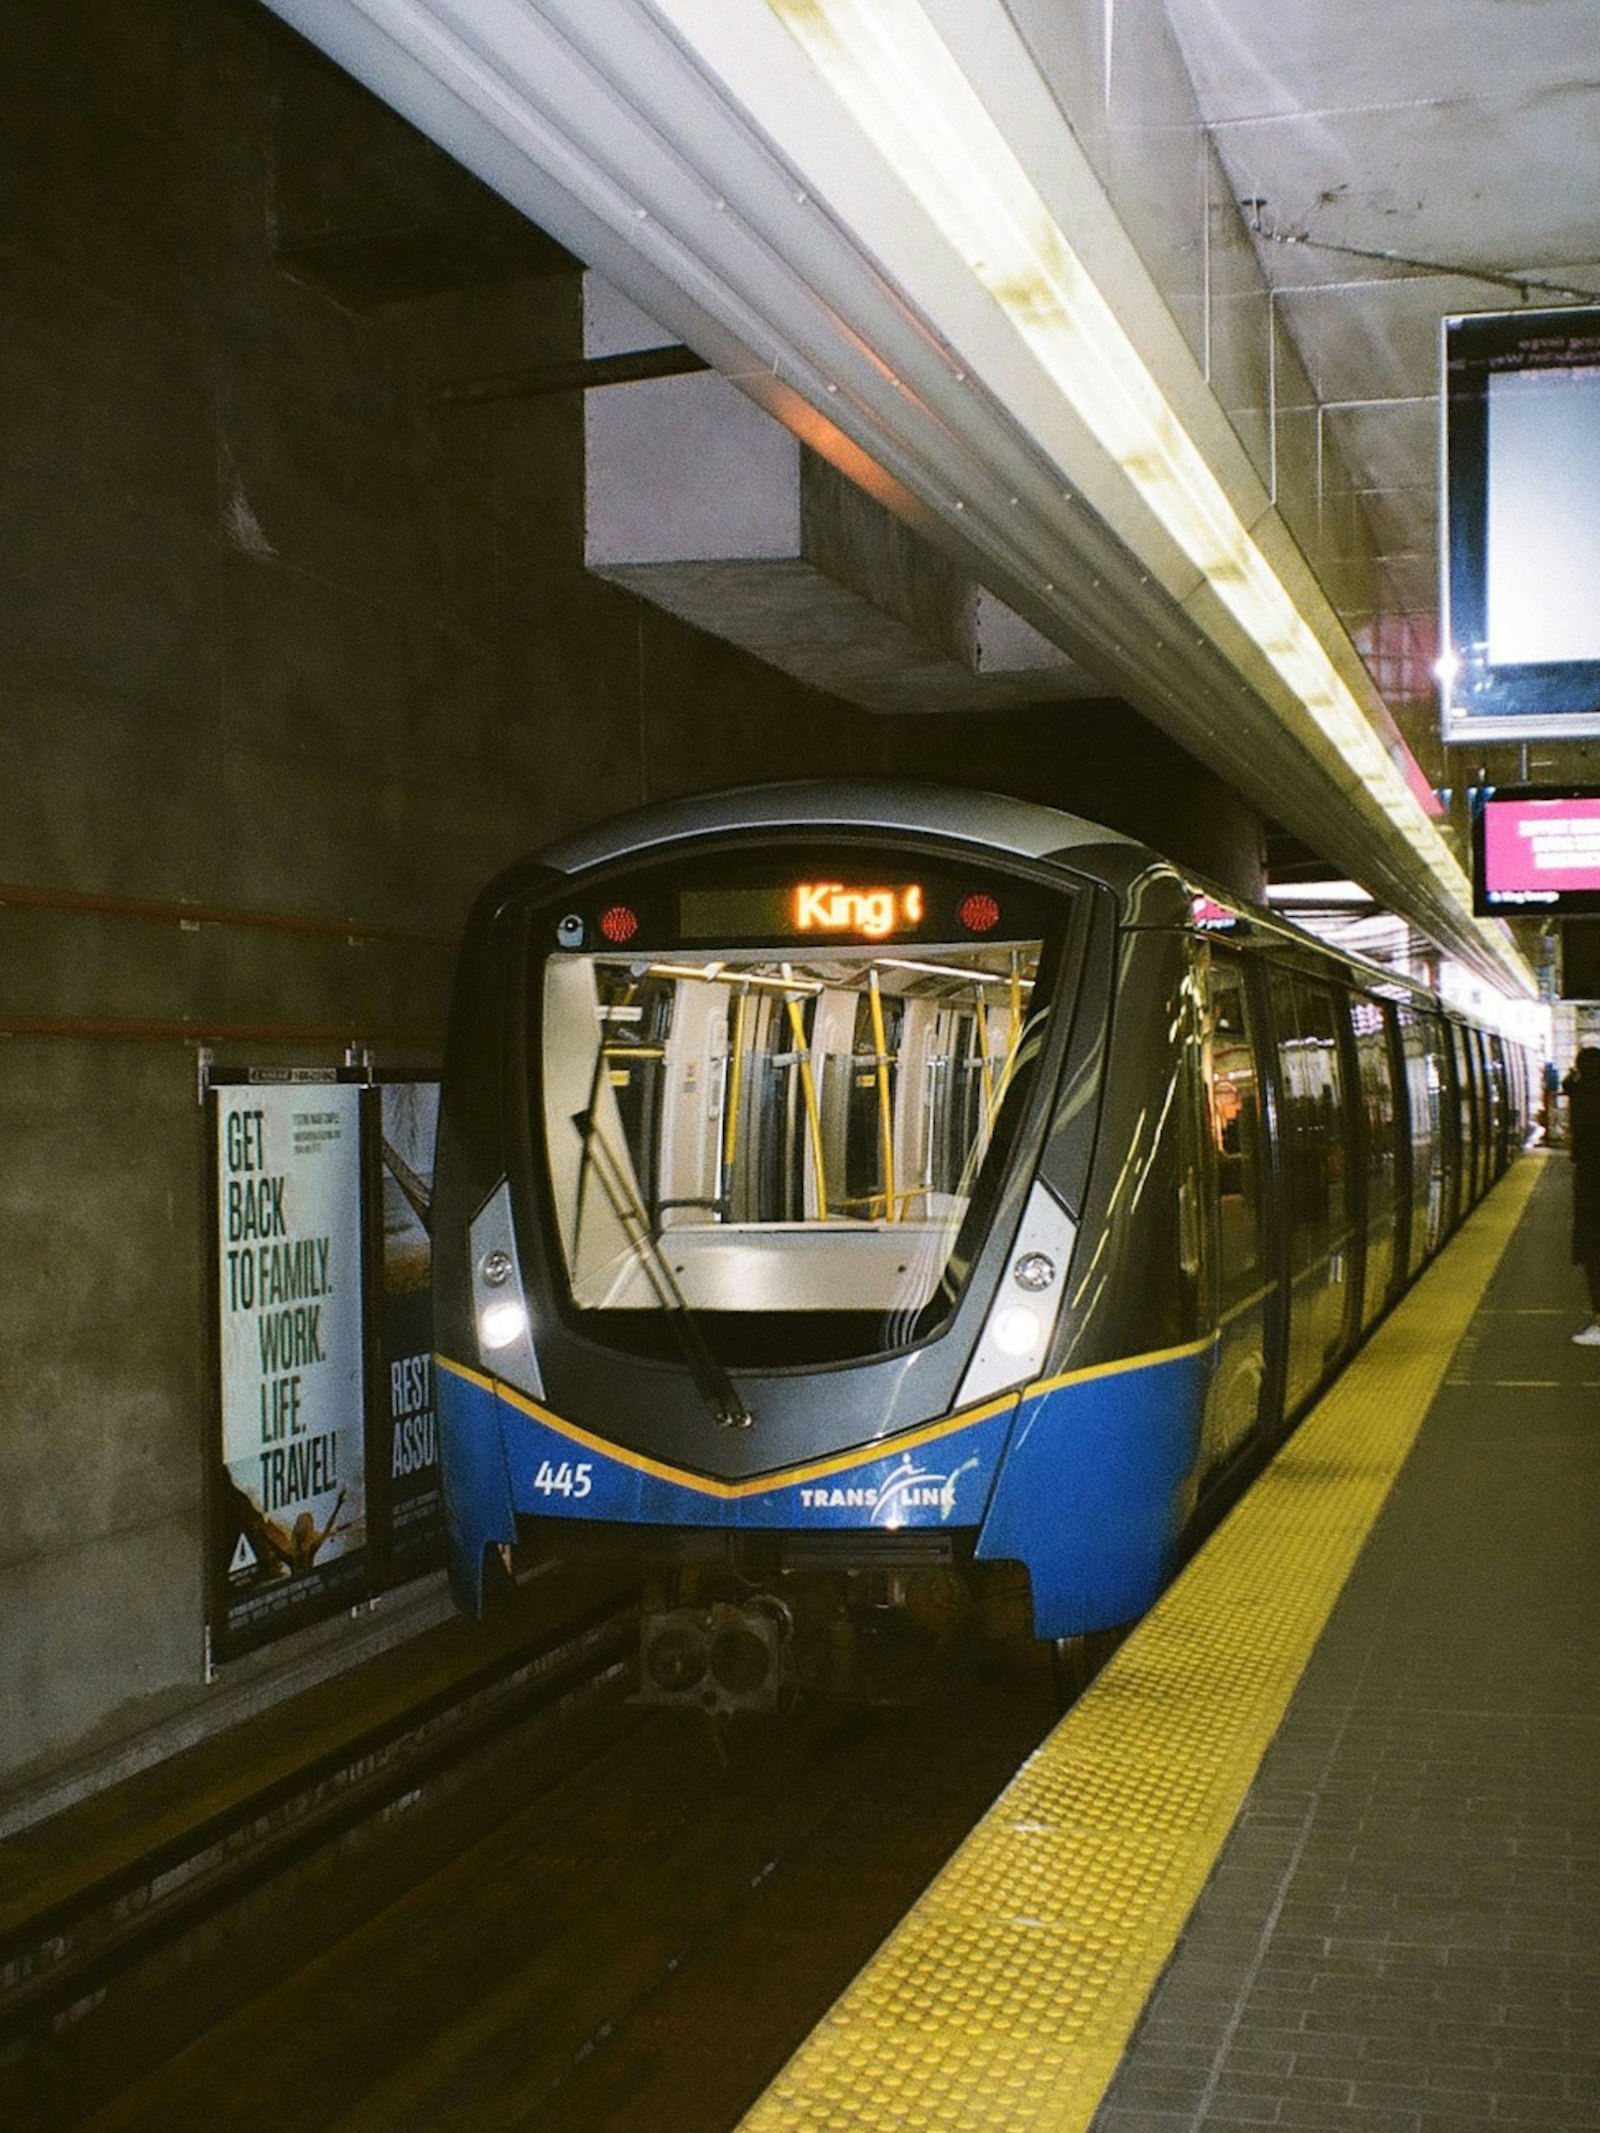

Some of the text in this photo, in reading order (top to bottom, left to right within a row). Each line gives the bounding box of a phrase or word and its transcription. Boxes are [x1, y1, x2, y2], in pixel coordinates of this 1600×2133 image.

[797, 884, 894, 936] King
[227, 1110, 264, 1173] GET
[228, 1176, 286, 1242] BACK
[227, 1237, 333, 1312] TO FAMILY.
[258, 1304, 326, 1375] WORK.
[260, 1375, 306, 1443] LIFE.
[391, 1353, 430, 1417] REST
[260, 1431, 337, 1513] TRAVEL!
[534, 1461, 592, 1498] 445
